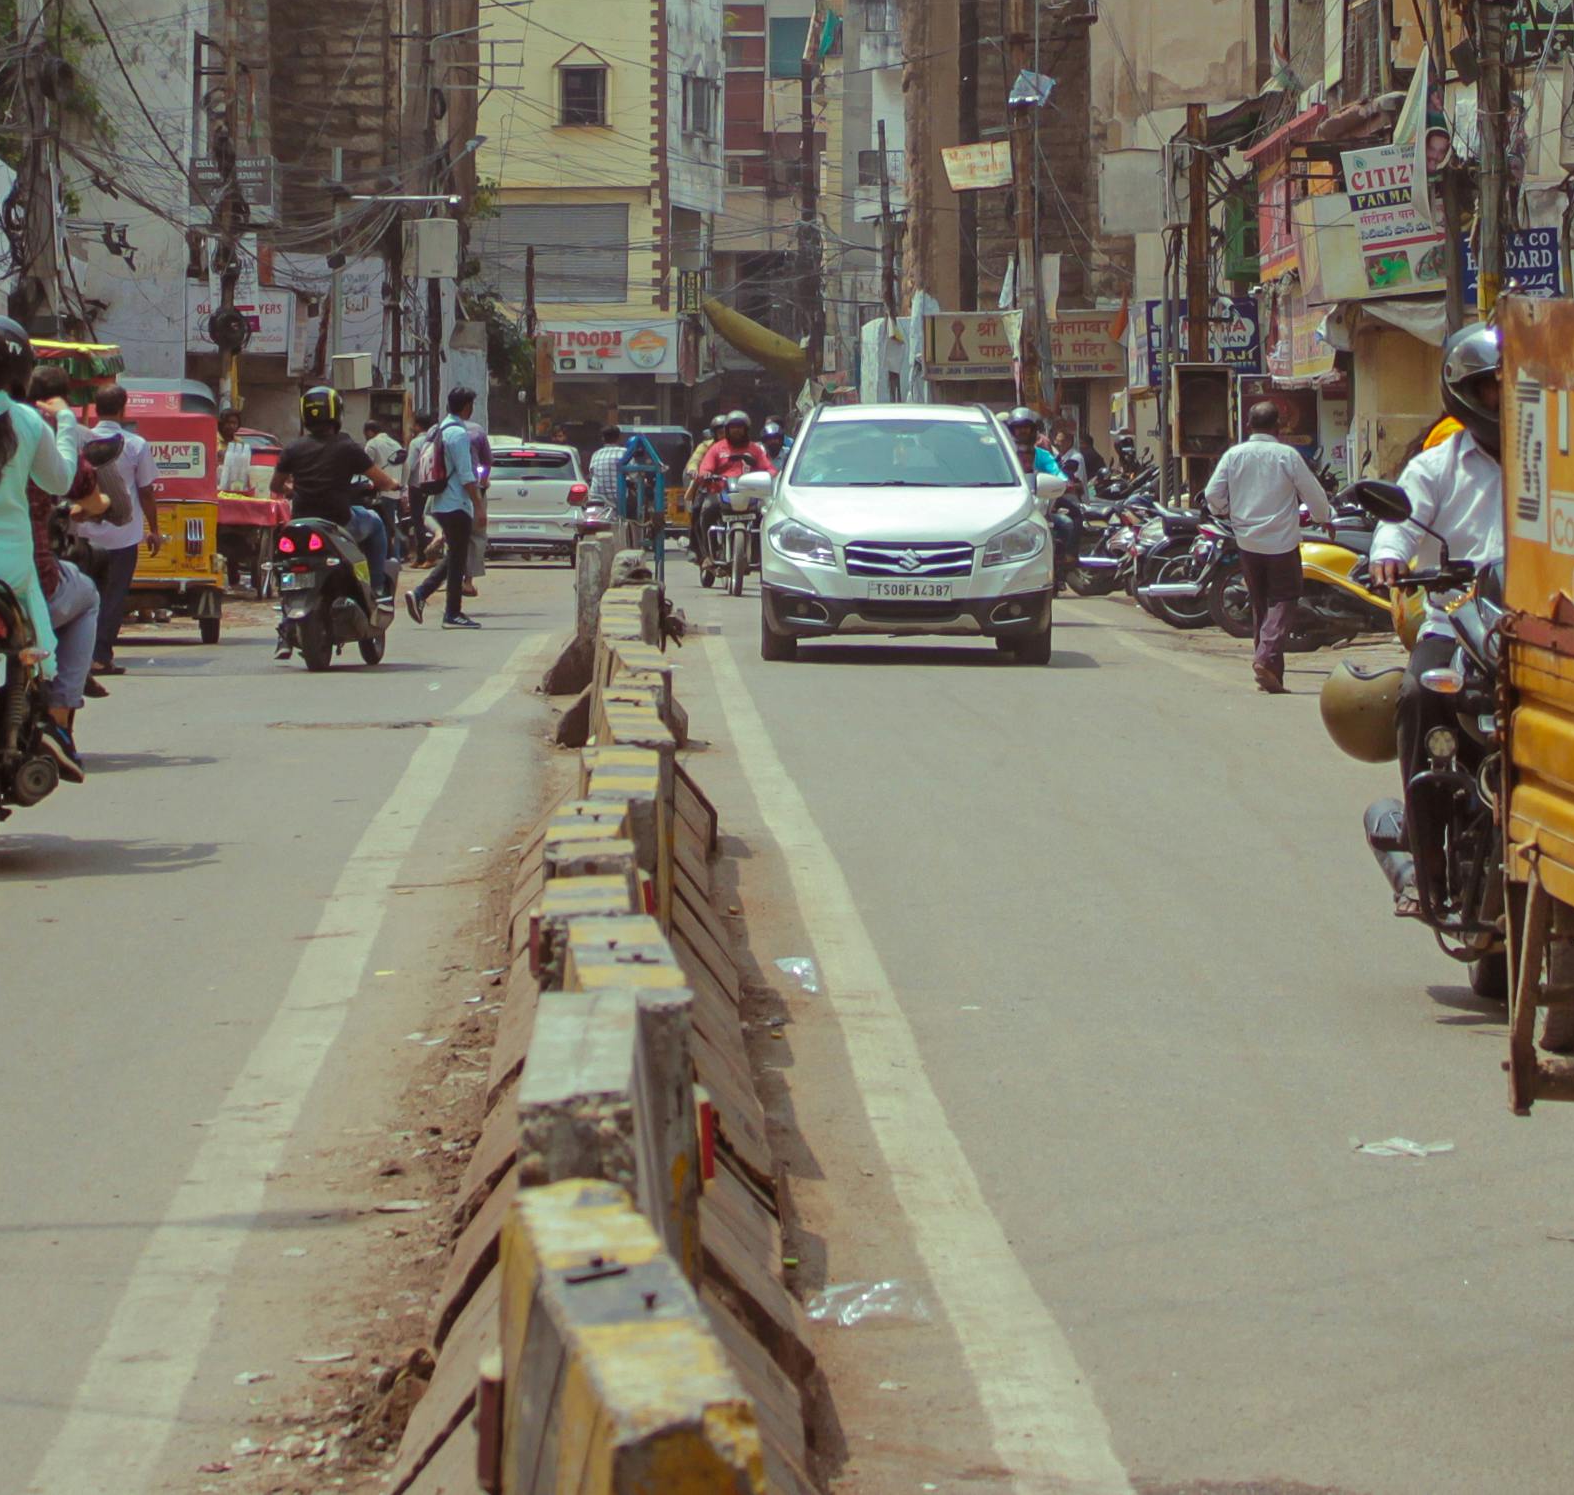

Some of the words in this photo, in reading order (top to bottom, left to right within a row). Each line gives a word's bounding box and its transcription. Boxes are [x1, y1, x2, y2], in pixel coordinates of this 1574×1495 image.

[1350, 163, 1413, 192] CITIZ
[1357, 192, 1387, 209] PAN
[1529, 232, 1550, 246] CO
[567, 330, 622, 347] FOODS
